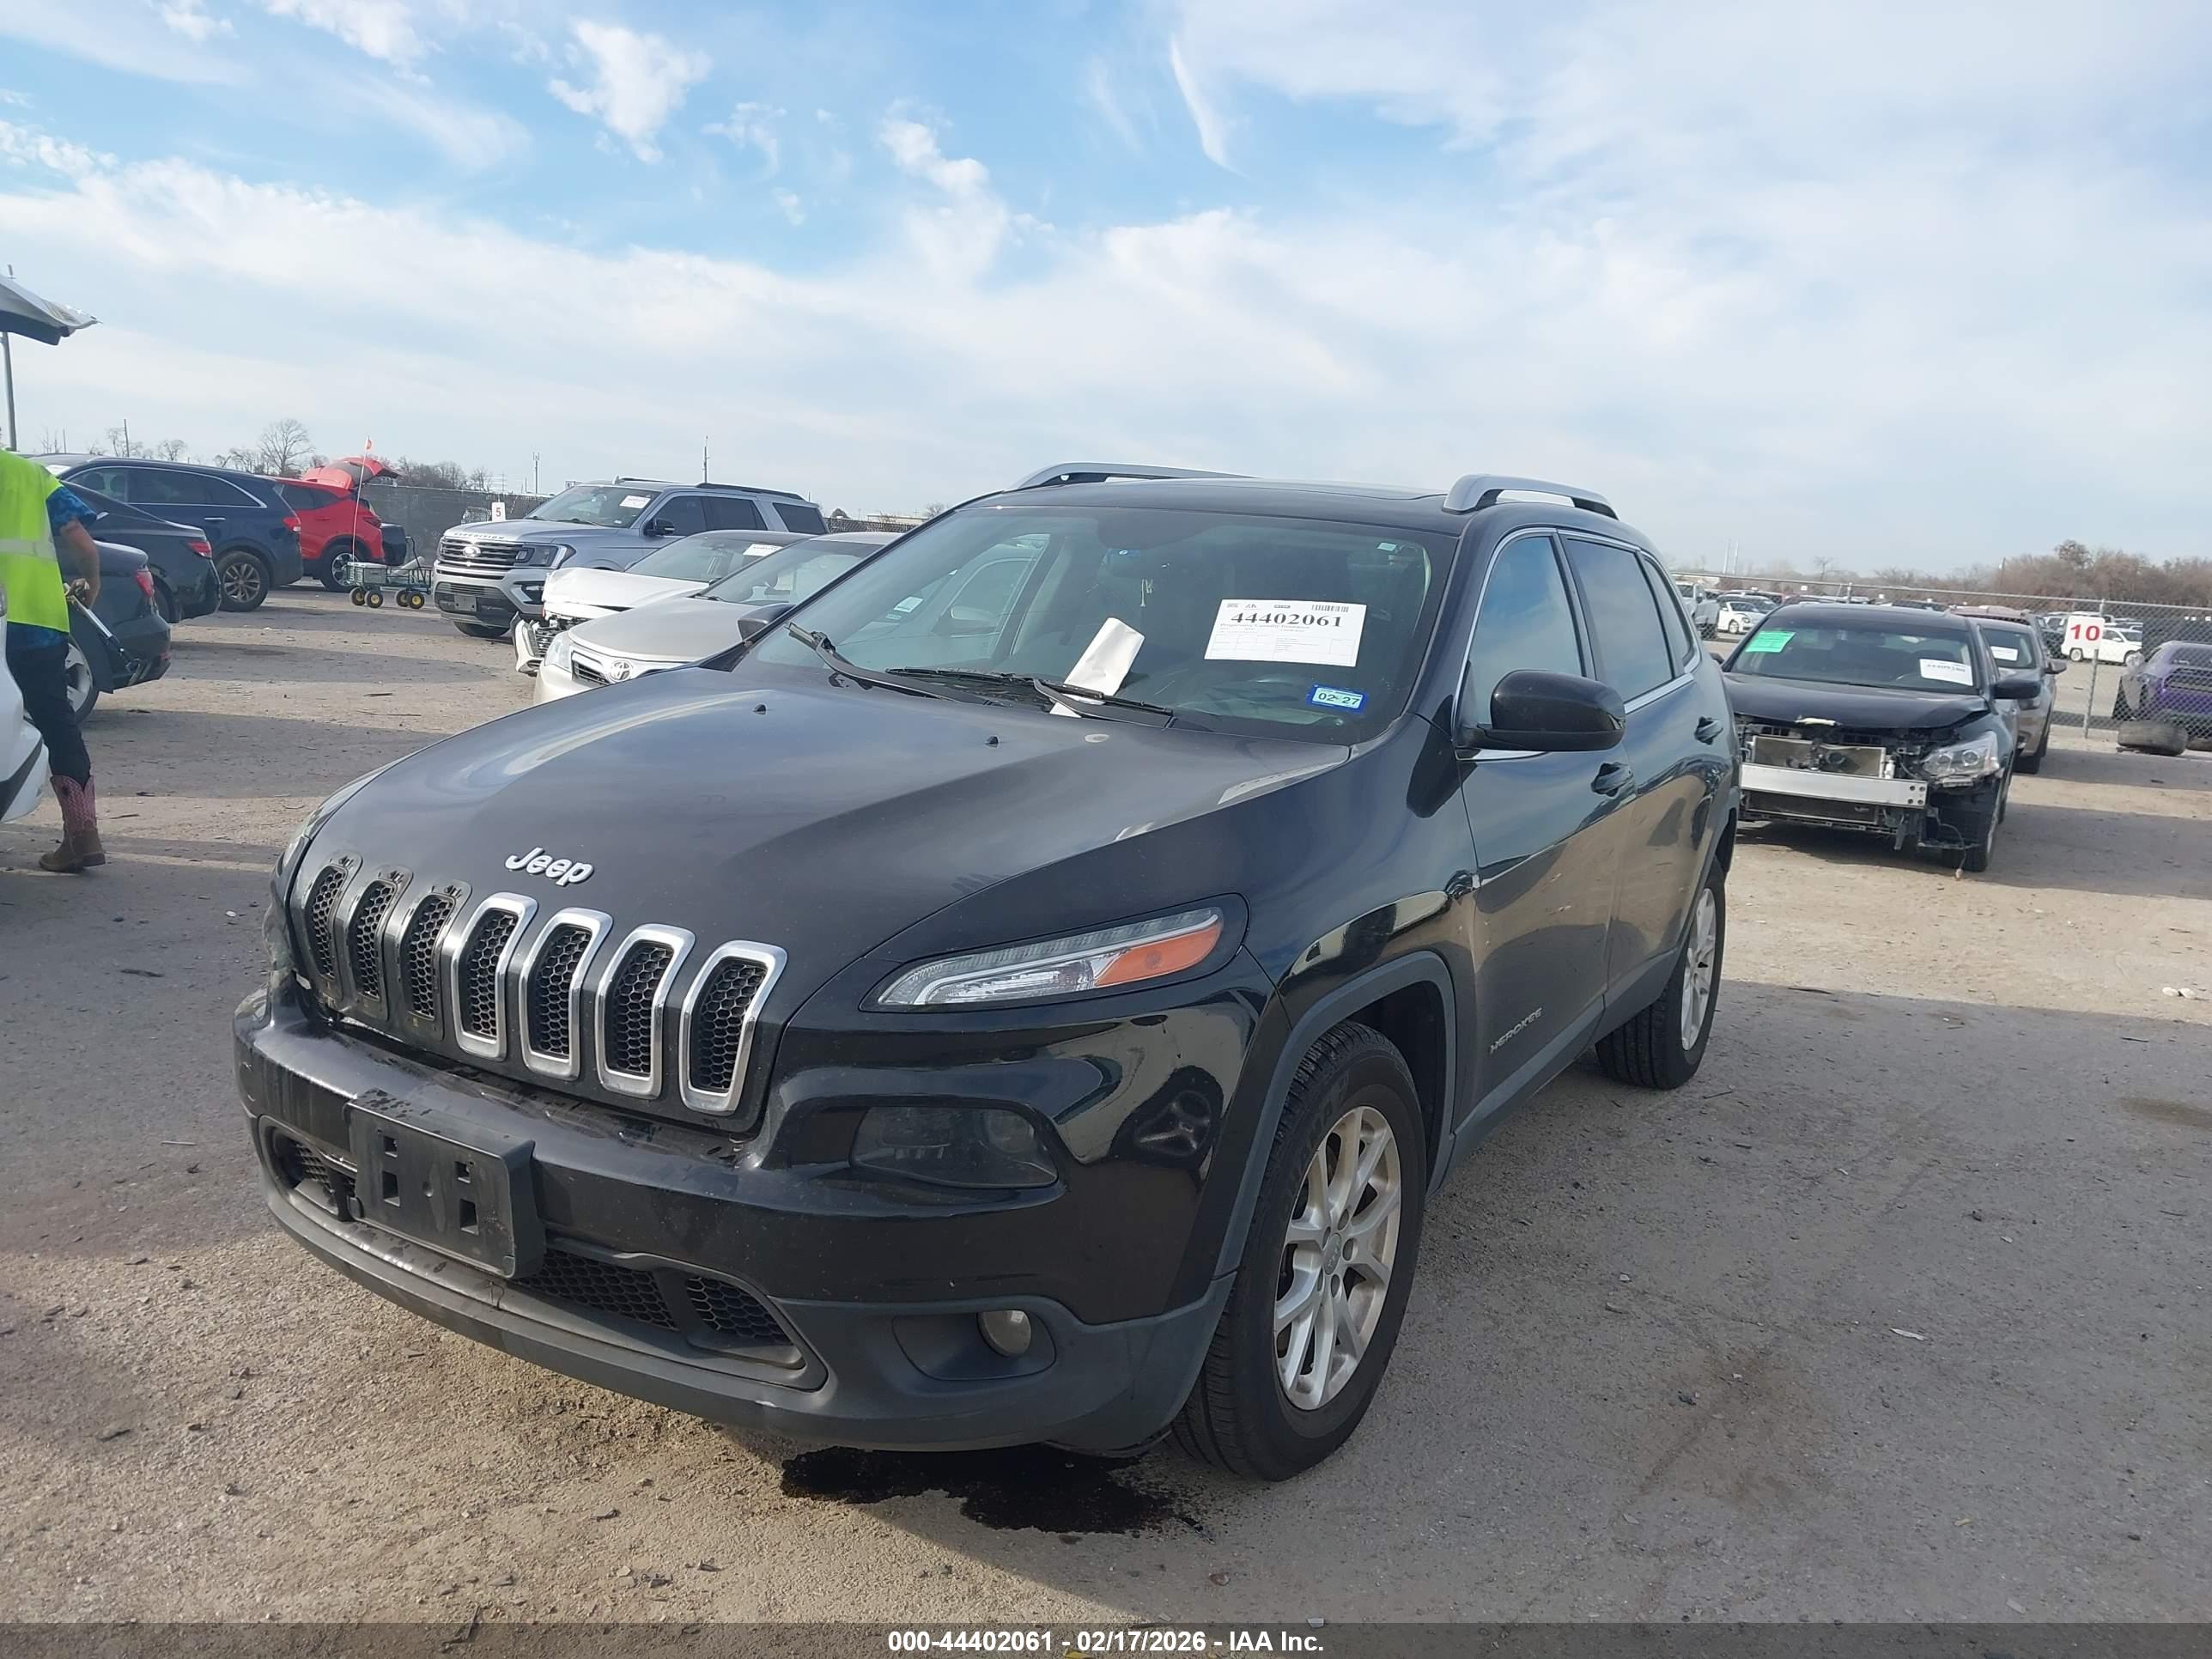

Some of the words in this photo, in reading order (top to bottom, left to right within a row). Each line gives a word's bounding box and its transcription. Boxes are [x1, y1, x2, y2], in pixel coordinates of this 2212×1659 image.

[495, 507, 501, 517] 5
[1231, 612, 1342, 628] 44402061
[2070, 623, 2100, 641] 10
[505, 847, 594, 887] Jeep
